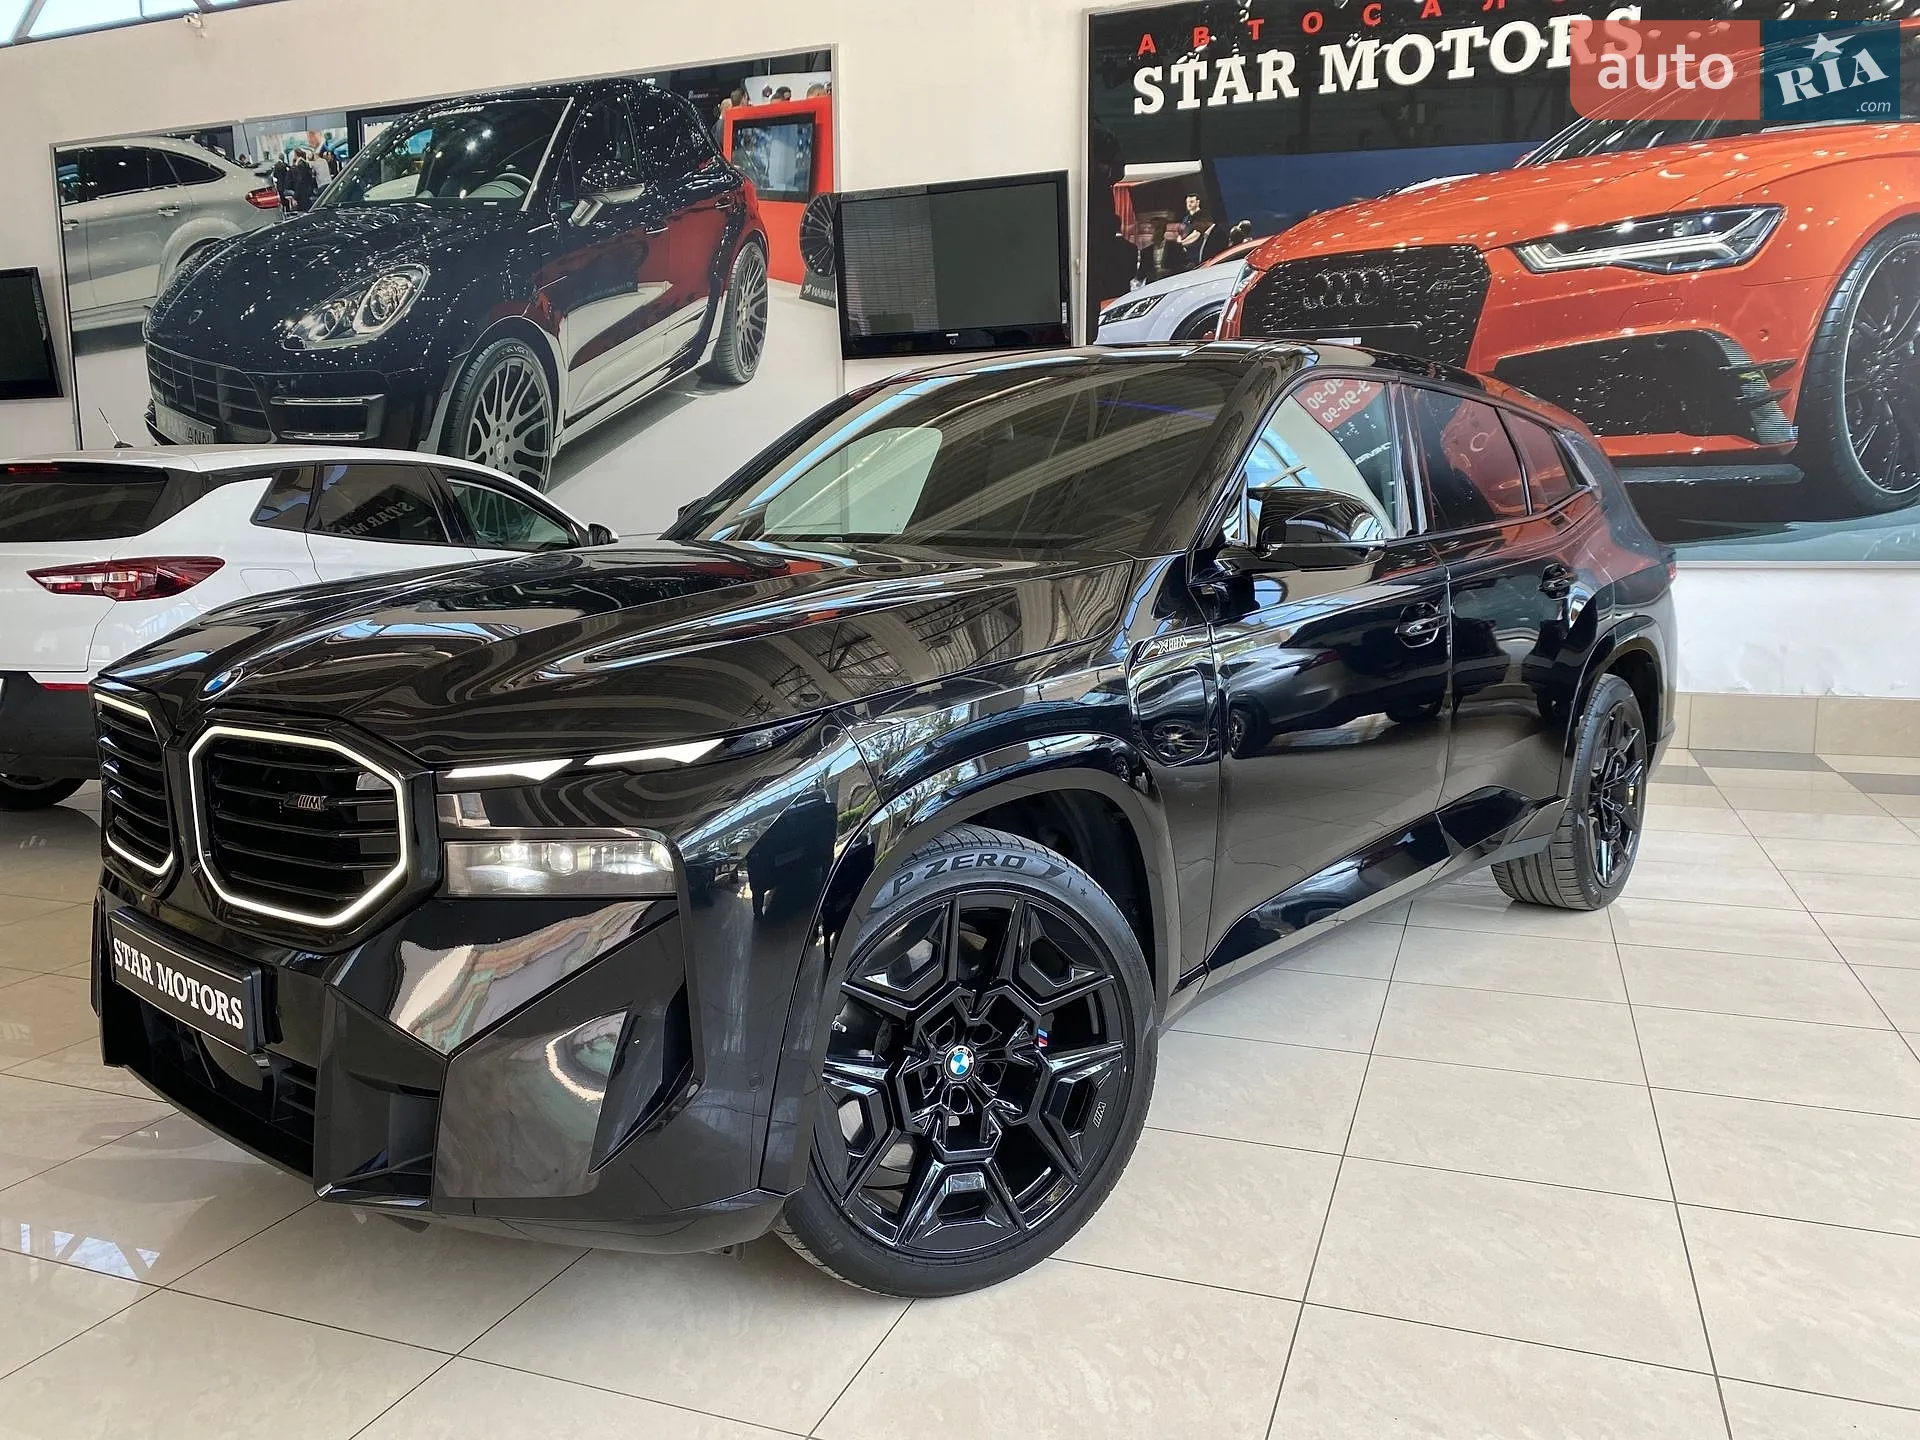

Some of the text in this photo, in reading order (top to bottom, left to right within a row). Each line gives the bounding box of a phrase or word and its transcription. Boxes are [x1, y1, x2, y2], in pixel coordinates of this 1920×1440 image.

[1134, 5, 1642, 115] STAR MOTORS
[892, 853, 1027, 897] P ZERO
[113, 937, 244, 1030] STAR MOTORS
